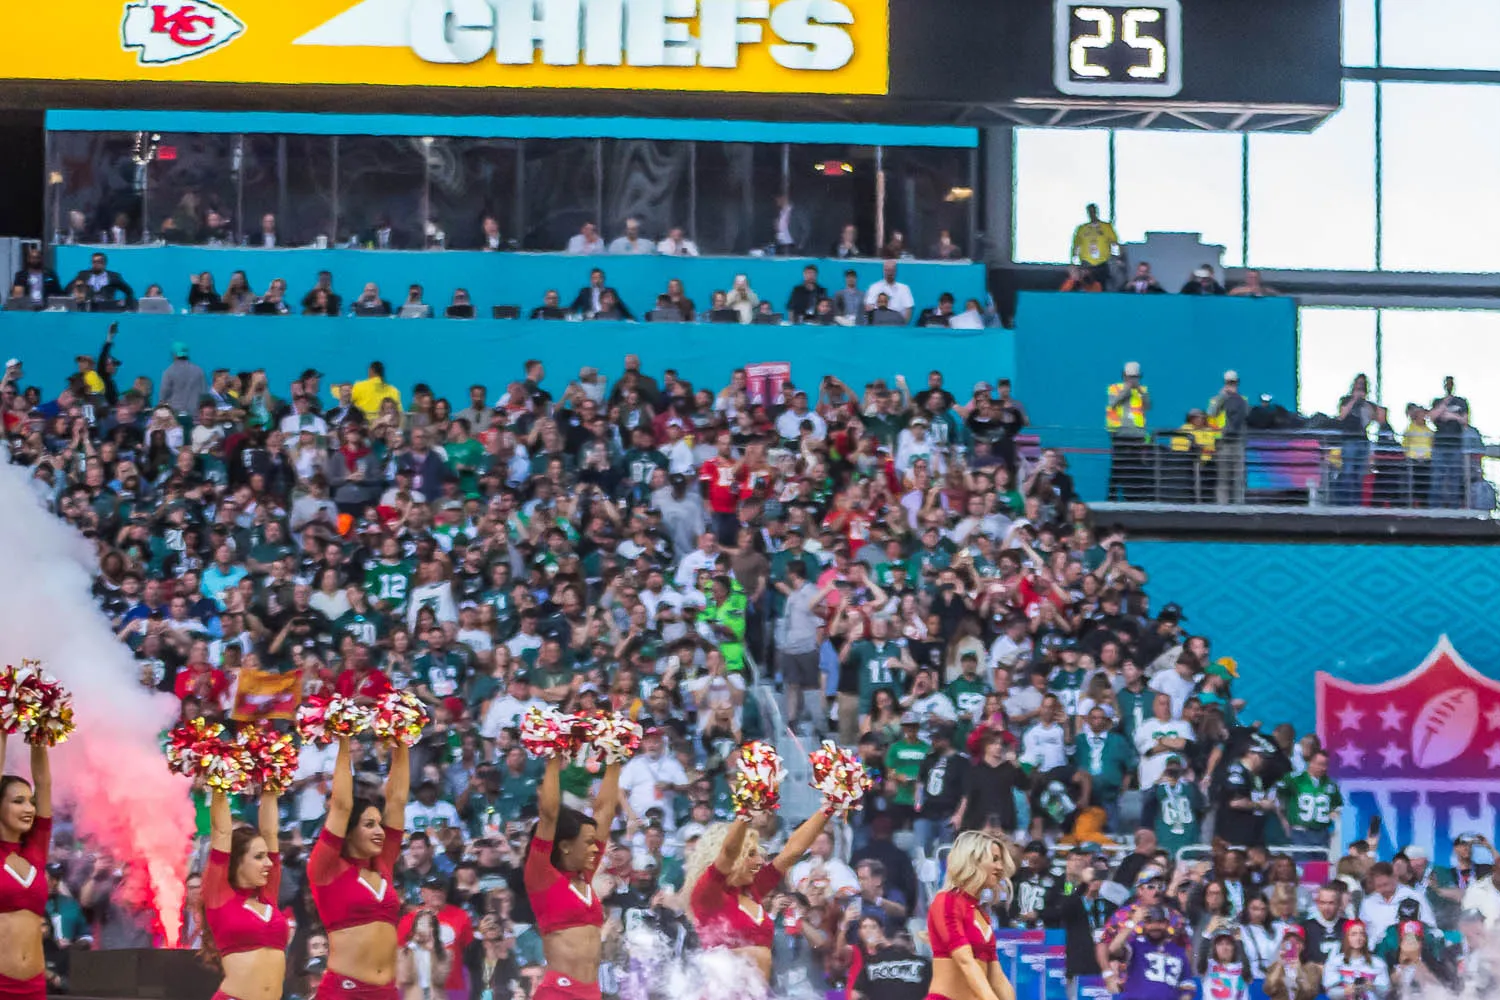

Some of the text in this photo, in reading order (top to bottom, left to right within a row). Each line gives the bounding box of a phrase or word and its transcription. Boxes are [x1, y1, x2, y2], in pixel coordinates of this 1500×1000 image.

[409, 0, 855, 71] CHIEFS
[1070, 7, 1167, 79] 25
[379, 573, 408, 599] 12
[1298, 793, 1332, 825] 92
[1143, 952, 1183, 987] 33
